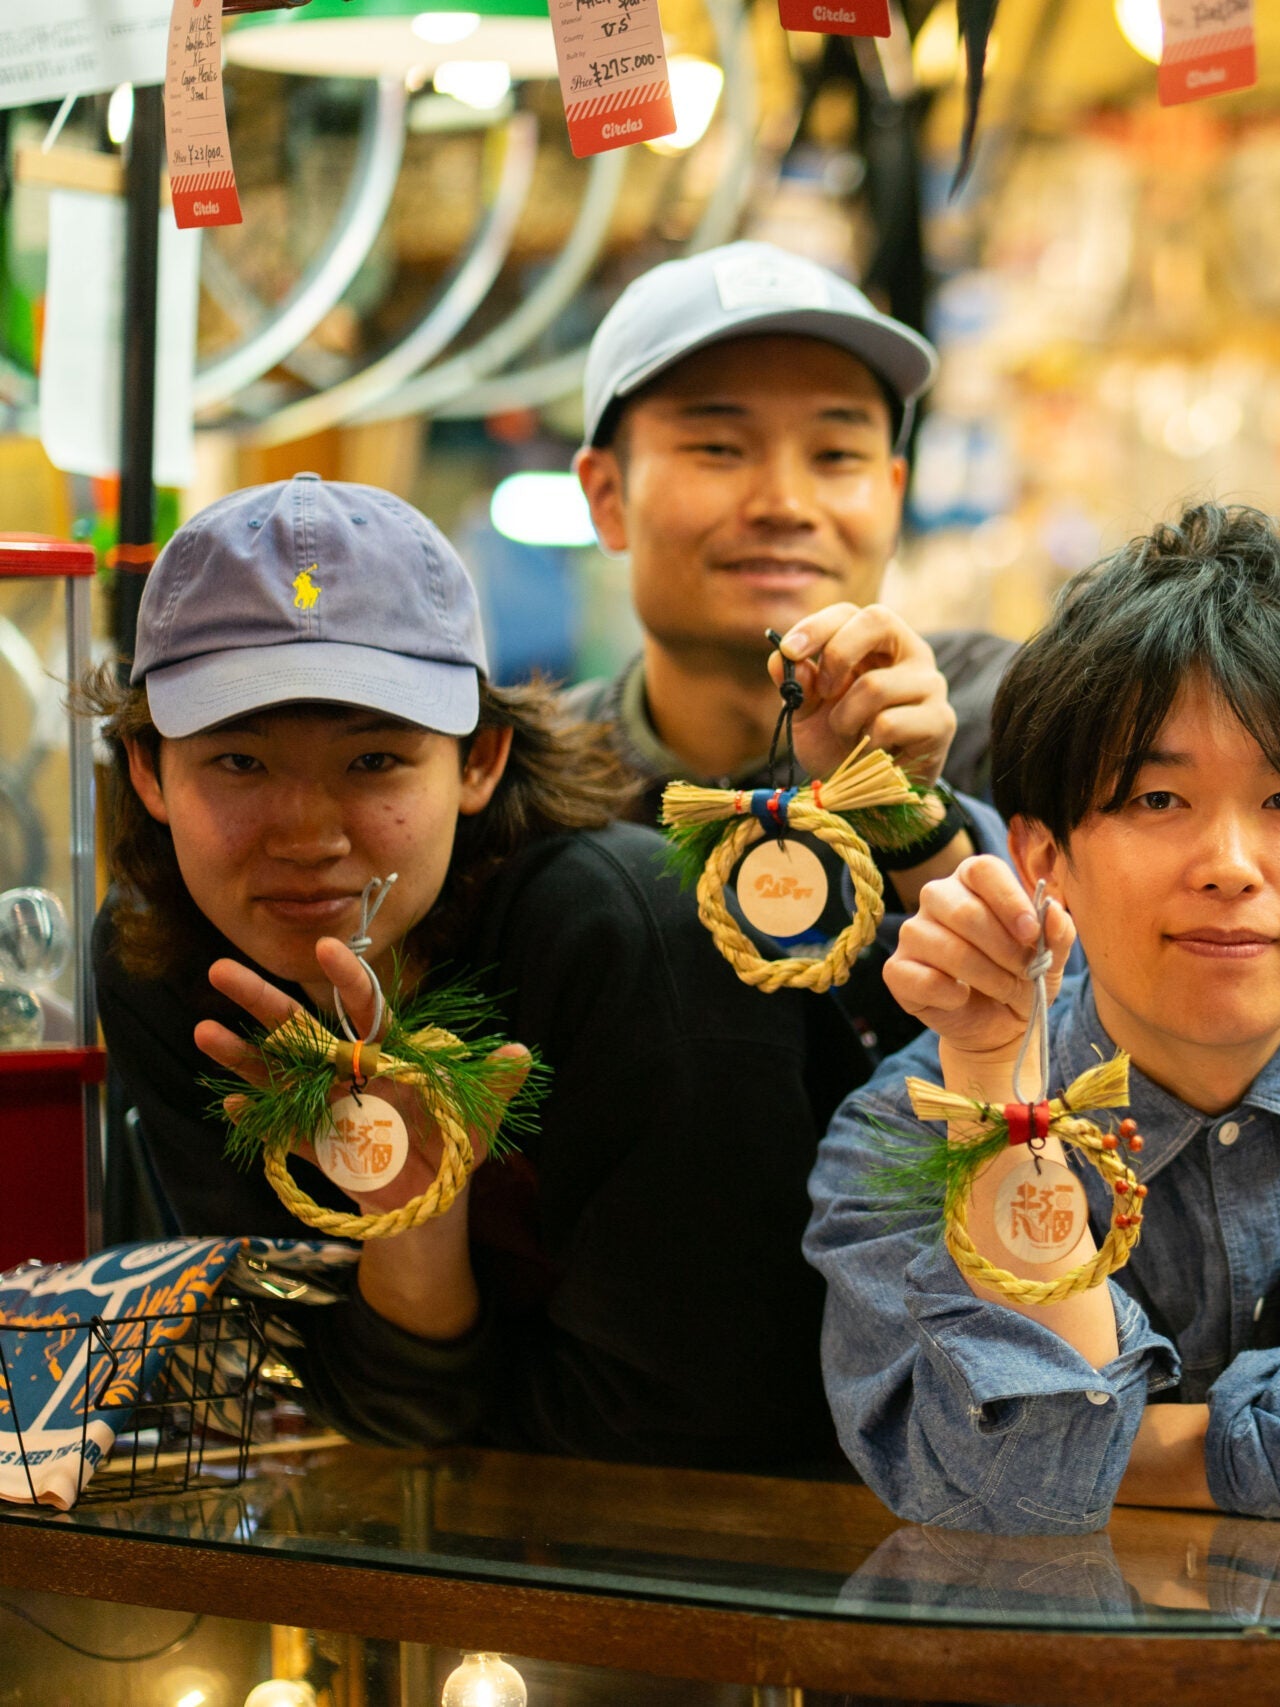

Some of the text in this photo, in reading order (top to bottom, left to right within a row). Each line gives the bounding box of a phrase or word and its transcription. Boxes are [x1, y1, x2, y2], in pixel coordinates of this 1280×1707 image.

[812, 6, 857, 23] Circles
[570, 74, 593, 91] Price
[602, 118, 643, 139] Circles
[193, 201, 221, 216] Circles
